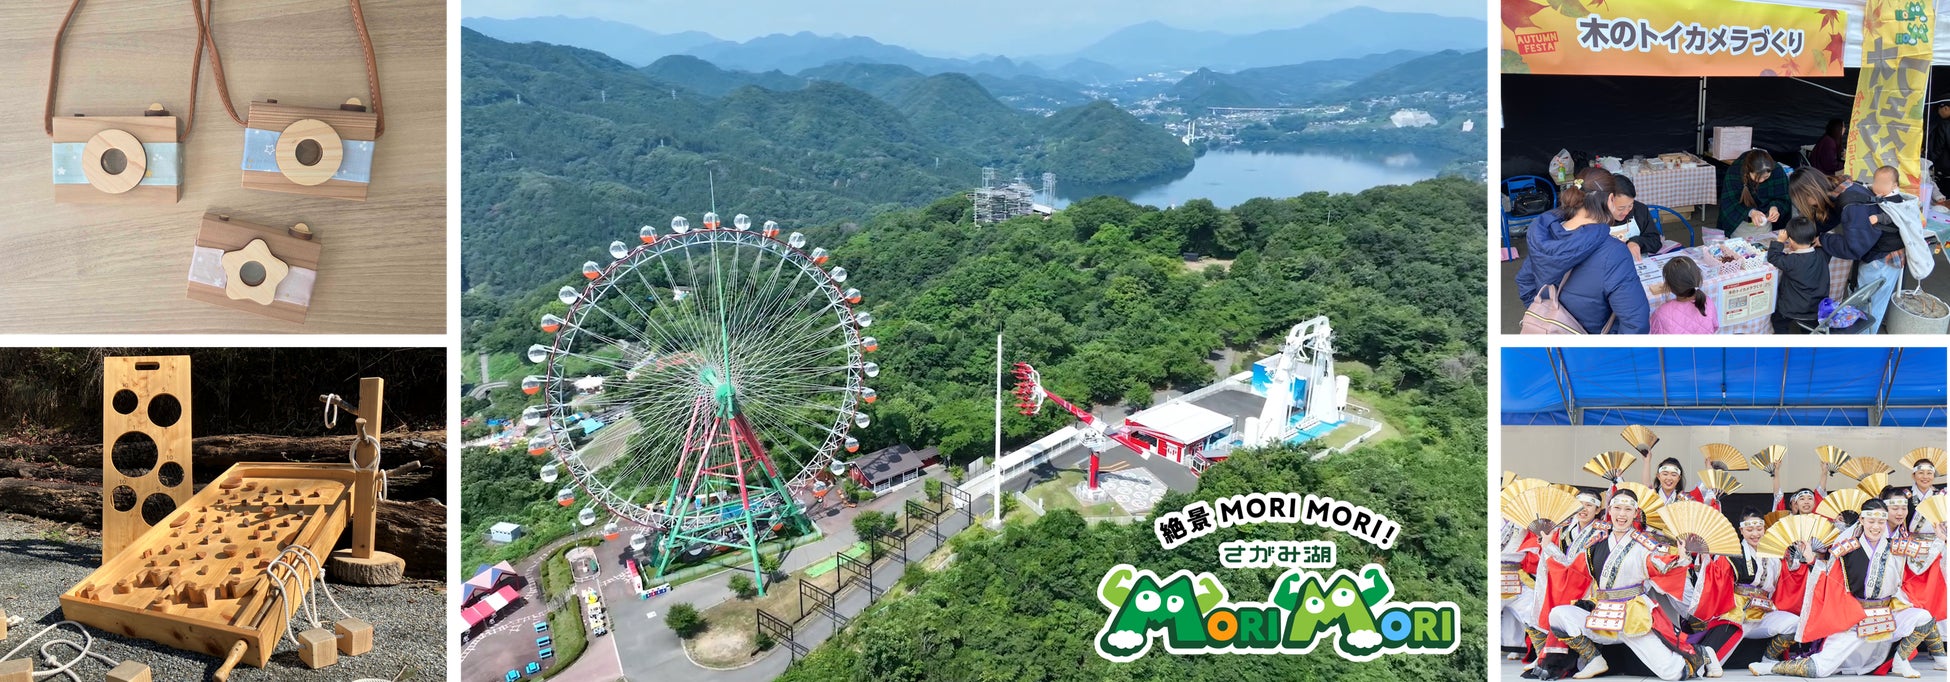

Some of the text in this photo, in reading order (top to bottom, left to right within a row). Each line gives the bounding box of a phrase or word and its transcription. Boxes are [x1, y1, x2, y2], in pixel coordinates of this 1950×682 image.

[1517, 31, 1558, 44] AUTUMN
[1578, 16, 1804, 54] 木のトイカメラづくり
[1524, 41, 1555, 53] FESTA
